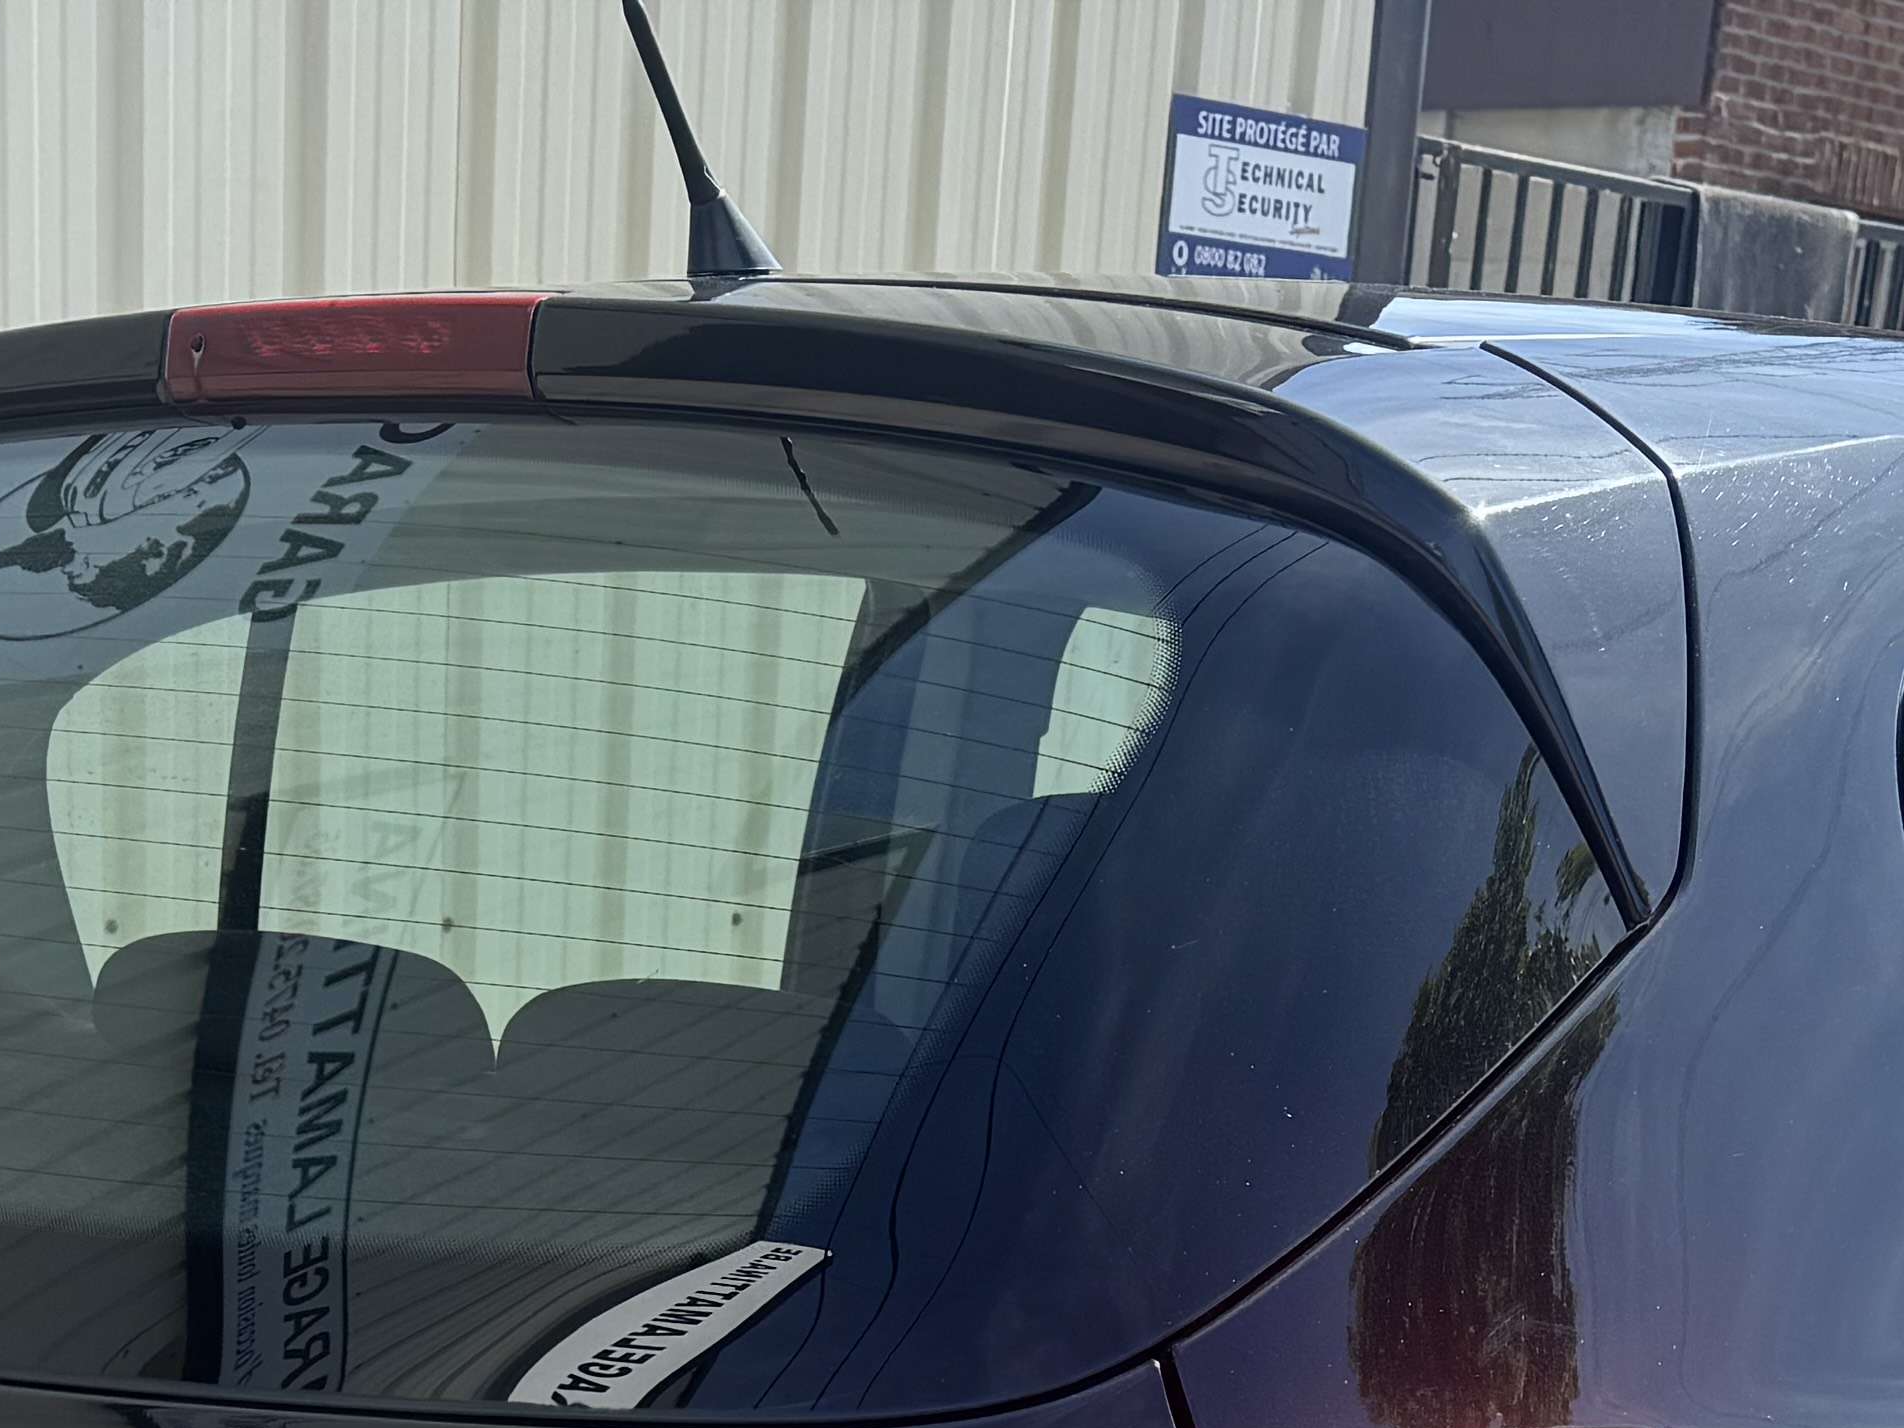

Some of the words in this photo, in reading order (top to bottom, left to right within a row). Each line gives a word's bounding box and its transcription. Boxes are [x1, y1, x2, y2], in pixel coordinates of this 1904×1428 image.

[1197, 110, 1233, 140] SITE
[1234, 116, 1307, 152] PROTÉGÉ
[1309, 129, 1340, 157] PAR
